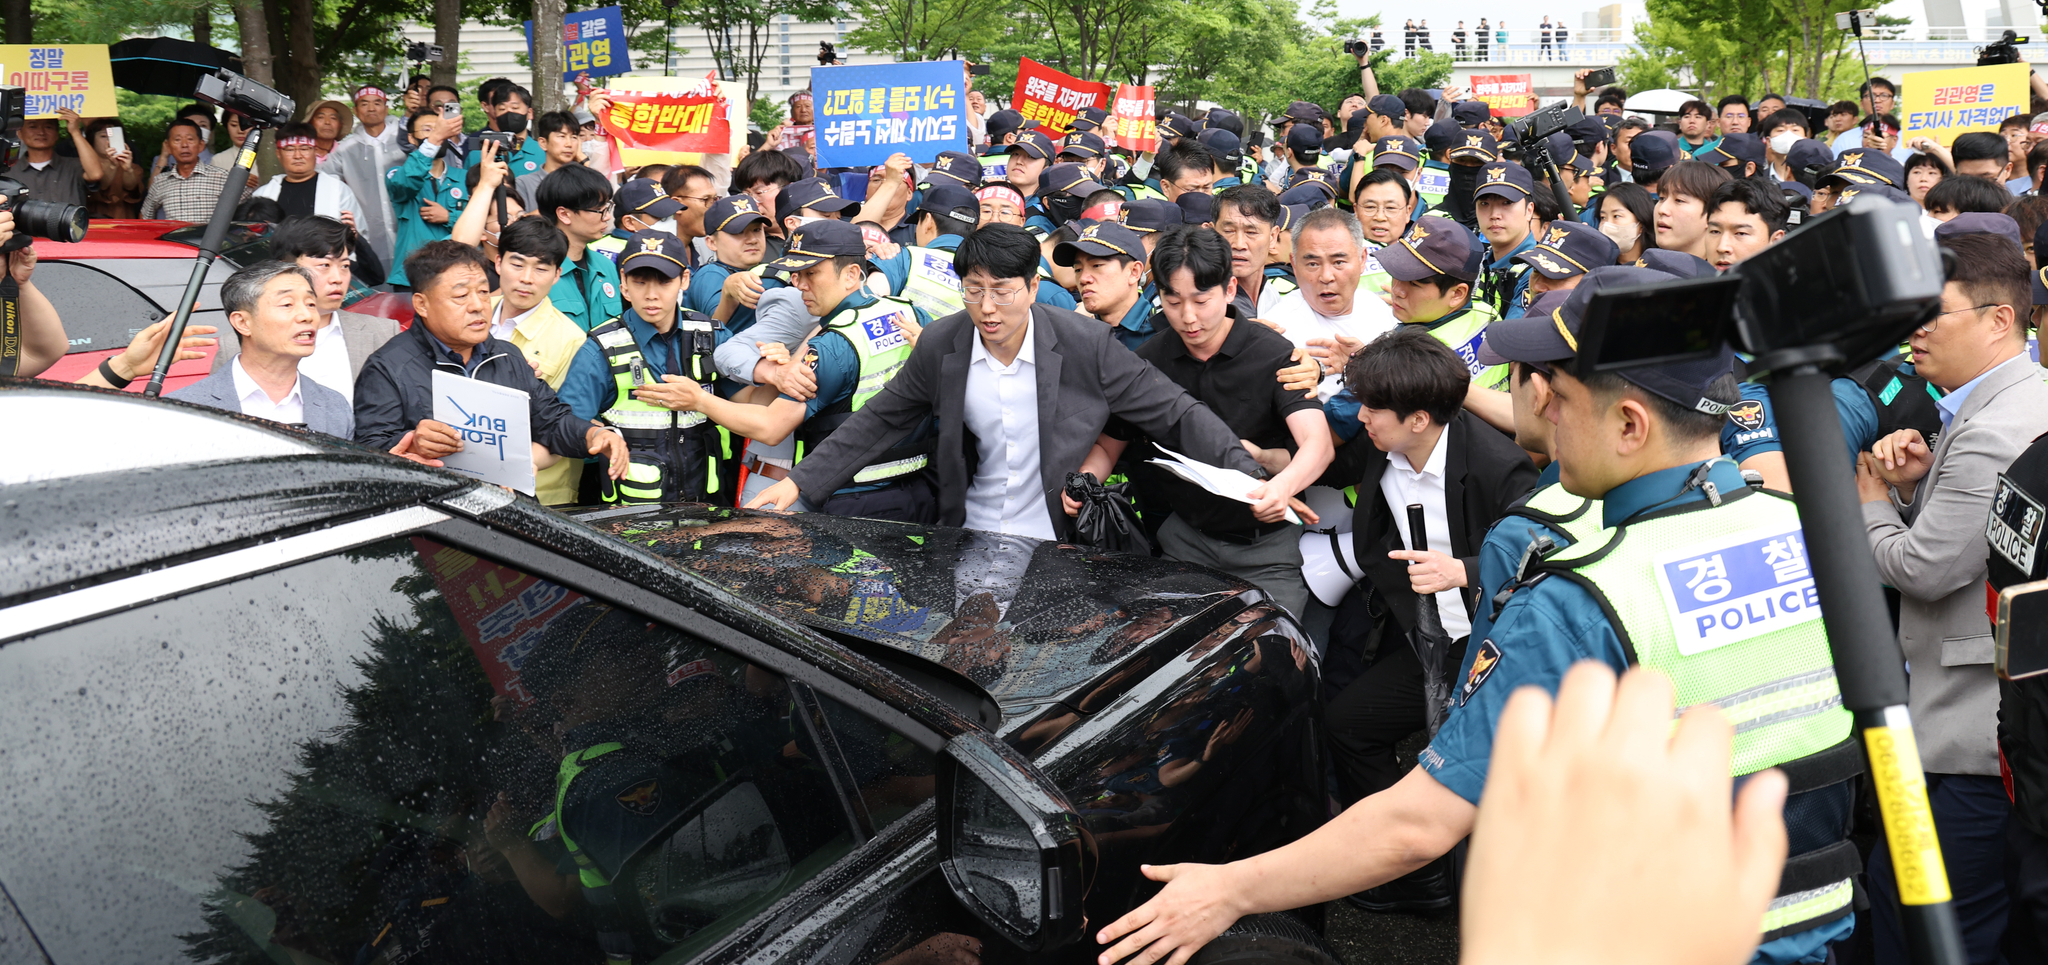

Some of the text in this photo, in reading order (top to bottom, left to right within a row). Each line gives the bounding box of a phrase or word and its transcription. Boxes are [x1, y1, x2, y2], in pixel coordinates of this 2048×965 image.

[563, 18, 607, 41] 열 같은
[29, 48, 64, 69] 정말
[10, 71, 89, 91] 이따구로
[1024, 76, 1098, 111] 완주를 지키자!
[1476, 82, 1527, 95] 완주를 지키자!
[1934, 83, 1995, 106] 김관영은
[25, 94, 85, 115] 할꺼야?
[823, 83, 956, 116] 누가 모를 줄 알고?
[1117, 97, 1145, 117] 완주를
[609, 101, 714, 134] 통합반대!
[874, 117, 908, 145] 재선
[910, 115, 958, 143] 도지사
[1907, 110, 1953, 131] 도지사
[1956, 105, 2020, 127] 자격없다
[824, 119, 872, 147] 노림수
[5, 300, 16, 334] Nikon
[866, 318, 885, 337] 경
[446, 395, 506, 433] BUK
[1996, 484, 2038, 540] 경 찰
[1990, 518, 2028, 568] POLICE
[1678, 534, 1809, 602] 경 찰
[1696, 586, 1819, 639] POLICE
